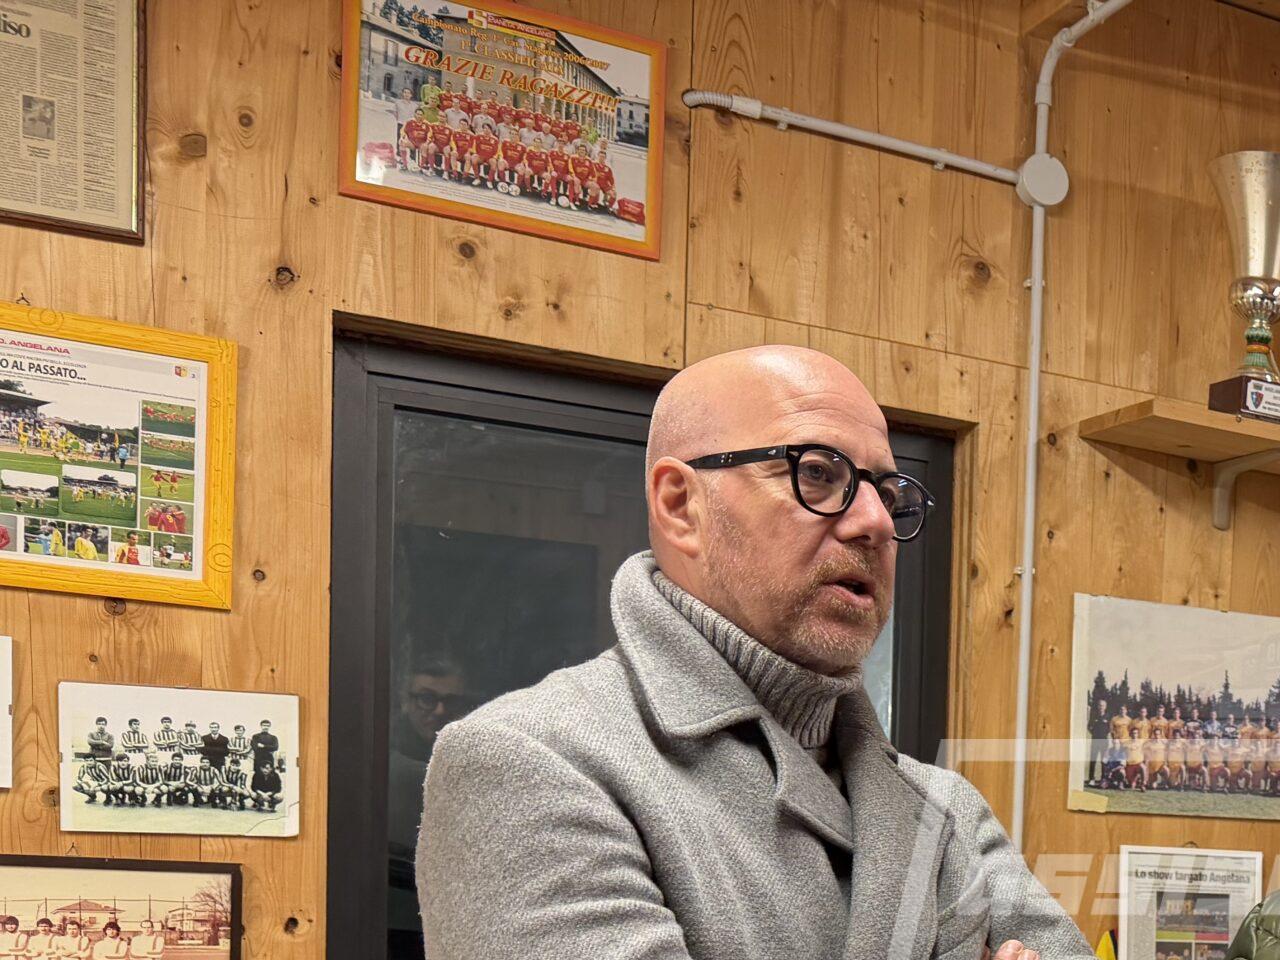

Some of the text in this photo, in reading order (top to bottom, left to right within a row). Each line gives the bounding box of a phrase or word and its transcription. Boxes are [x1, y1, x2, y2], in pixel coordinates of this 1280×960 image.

[412, 12, 468, 35] Campionato
[474, 43, 565, 77] CLASSIFICATA
[404, 45, 621, 113] GRAZIE RAGAZZI!!!
[9, 339, 71, 356] ANGELANA
[11, 361, 26, 373] AL
[28, 363, 87, 381] PASSATO...
[1148, 870, 1172, 881] show
[1174, 871, 1208, 884] targato
[1209, 873, 1250, 886] Angelana
